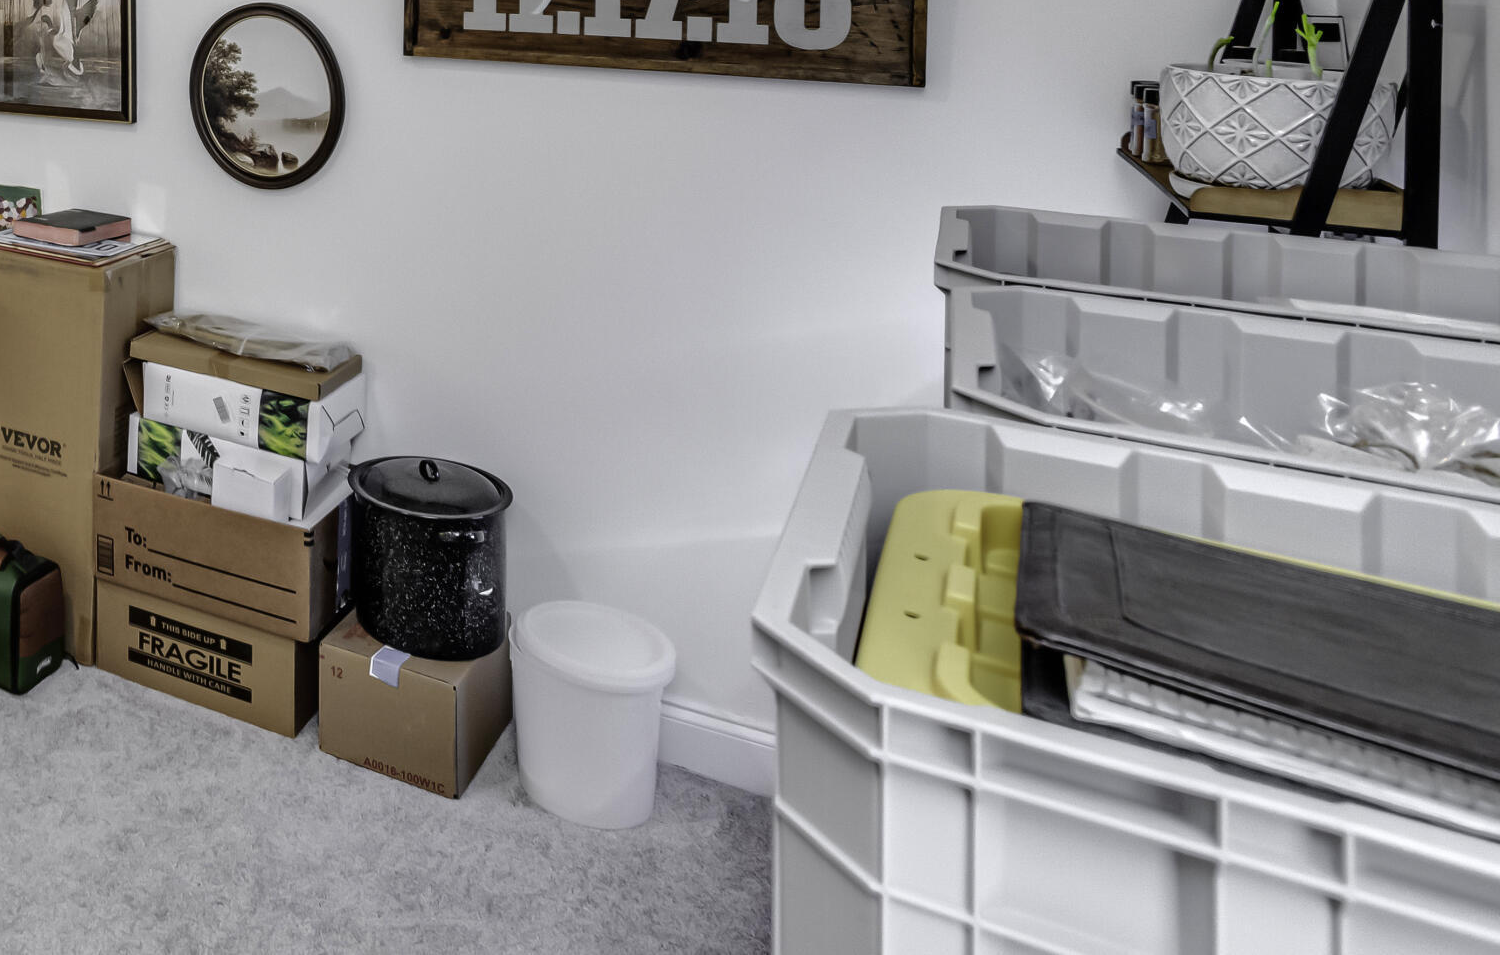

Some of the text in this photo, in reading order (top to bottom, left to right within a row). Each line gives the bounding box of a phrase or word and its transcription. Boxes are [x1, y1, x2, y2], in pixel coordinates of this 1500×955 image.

[1, 426, 62, 458] VEVOR
[125, 526, 147, 548] To:
[125, 554, 172, 583] From:
[161, 621, 216, 645] THIS SIDE UP
[138, 631, 242, 684] FRAGILE
[330, 665, 343, 679] 12
[147, 658, 232, 694] HANDLE WITH CARE
